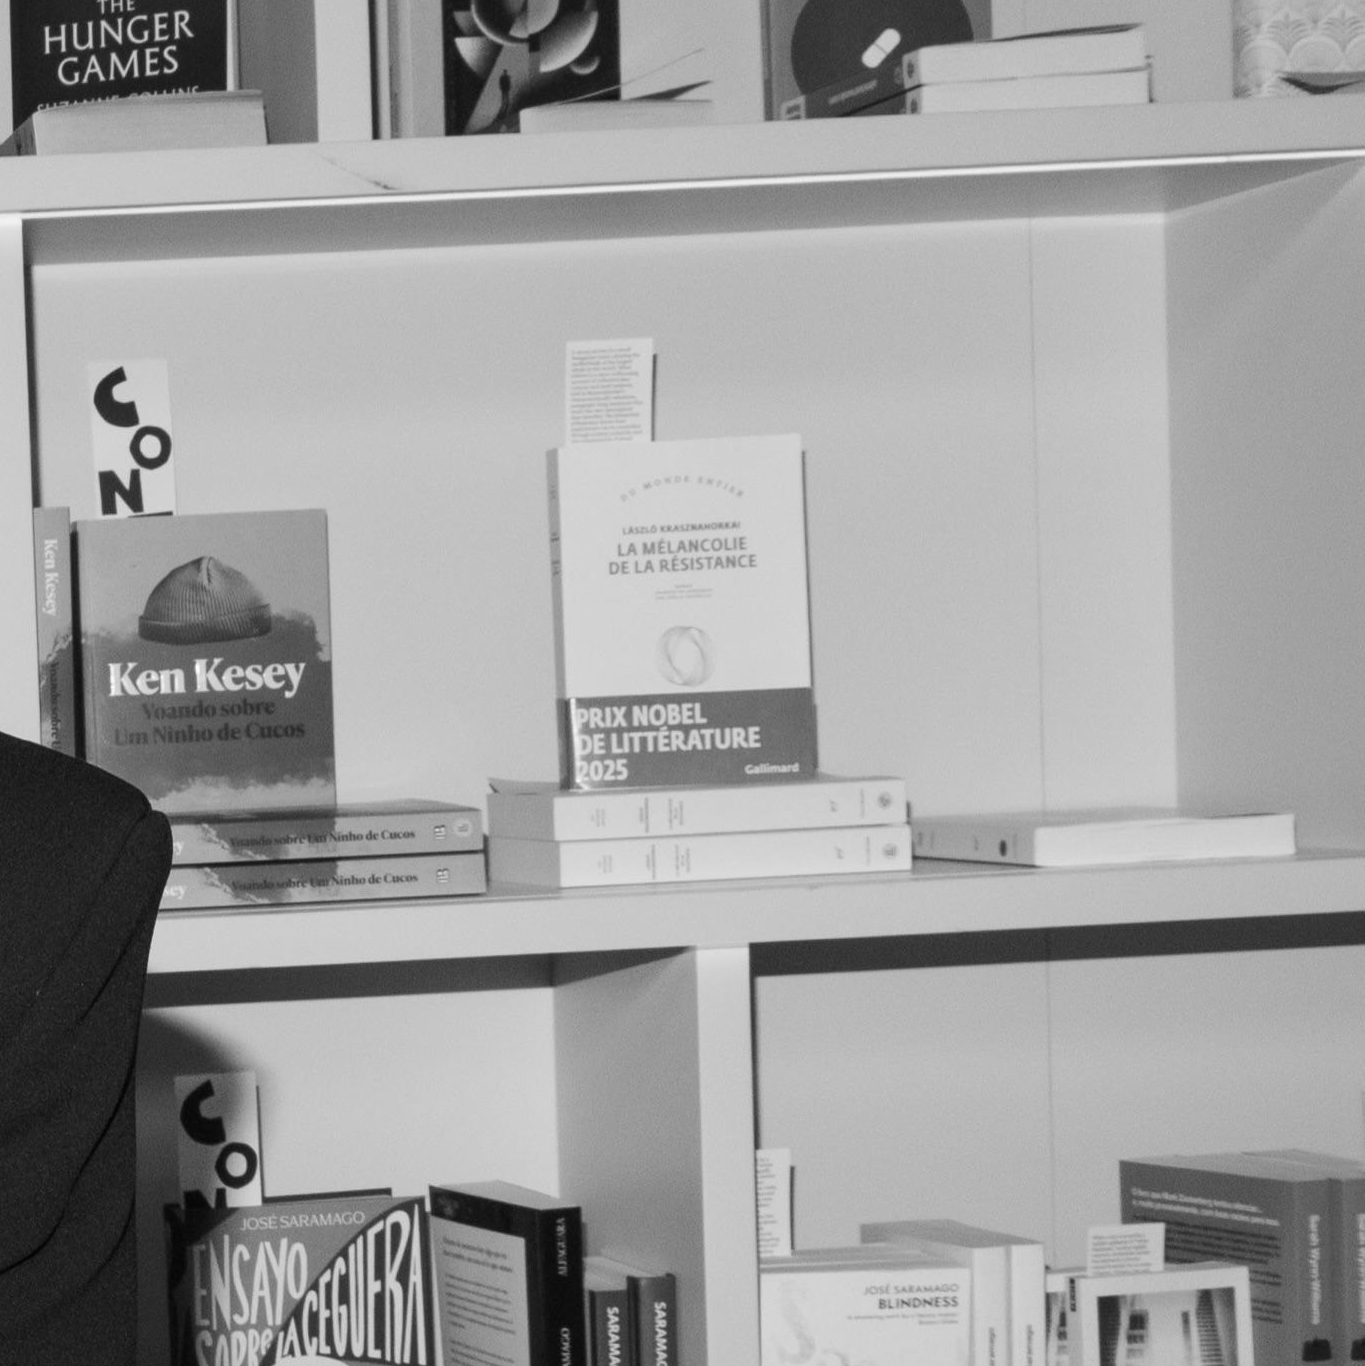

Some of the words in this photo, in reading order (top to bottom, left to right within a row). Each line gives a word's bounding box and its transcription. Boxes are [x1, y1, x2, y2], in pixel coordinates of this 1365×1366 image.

[43, 10, 194, 55] HUNGER
[58, 47, 179, 86] GAMES
[617, 542, 637, 557] LA
[642, 536, 747, 555] MÉLANCOLIE
[609, 561, 629, 575] DE
[634, 559, 655, 574] LA
[659, 554, 757, 572] RÉSISTANCE
[107, 662, 186, 697] Ken
[194, 658, 305, 698] Kesey
[575, 706, 628, 729] PRIX
[631, 702, 707, 728] NOBEL
[576, 734, 608, 755] DE
[610, 726, 761, 754] LITTÉRATURE
[576, 759, 628, 781] 2025
[745, 763, 800, 774] Gallimard
[241, 1214, 278, 1230] JOSÉ
[279, 1211, 365, 1228] SARAMAGO
[192, 1234, 308, 1331] ENSAYO
[302, 1203, 427, 1366] CEGUERA
[878, 1296, 959, 1311] BLINDNESS
